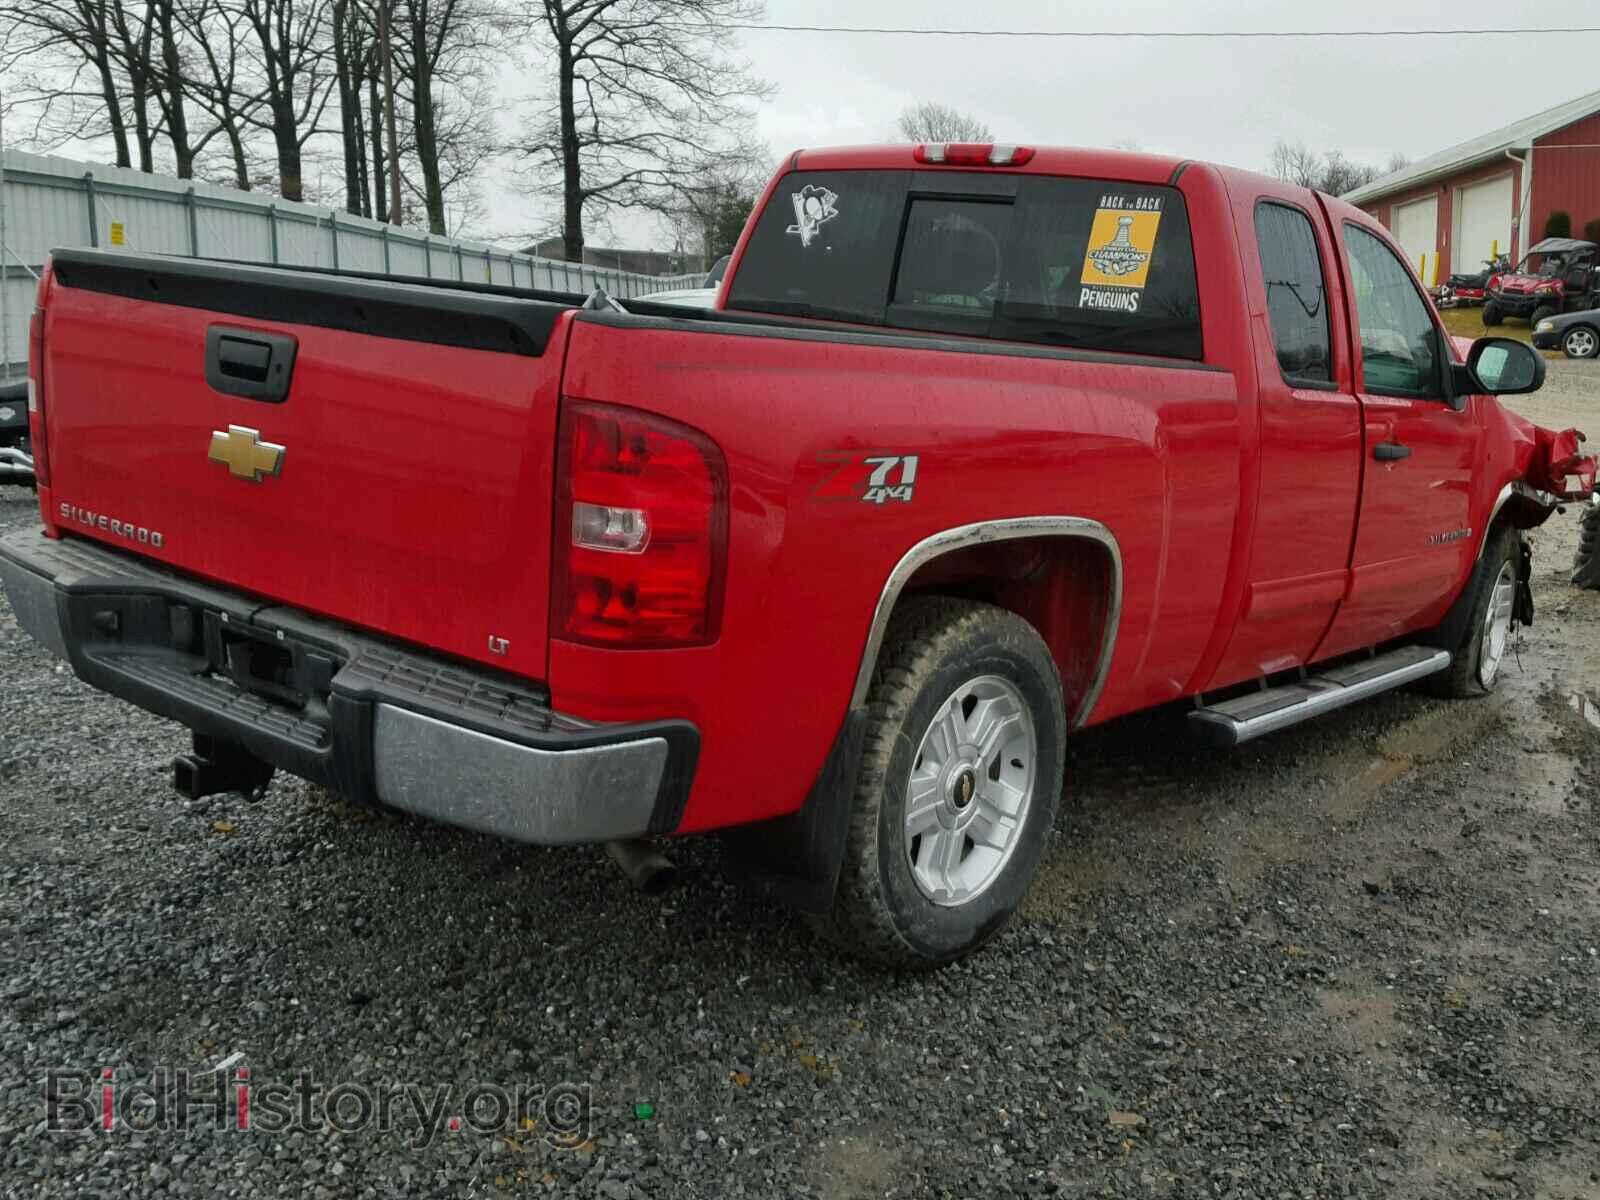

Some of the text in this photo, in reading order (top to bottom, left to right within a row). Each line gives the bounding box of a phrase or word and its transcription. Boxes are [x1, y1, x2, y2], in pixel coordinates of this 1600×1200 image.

[1100, 196, 1124, 208] BACK
[1135, 196, 1161, 210] BACK
[1088, 250, 1147, 261] CHAMPIONS
[1079, 288, 1139, 312] PENGUINS
[60, 502, 164, 548] SILVERADO
[488, 634, 510, 656] LT
